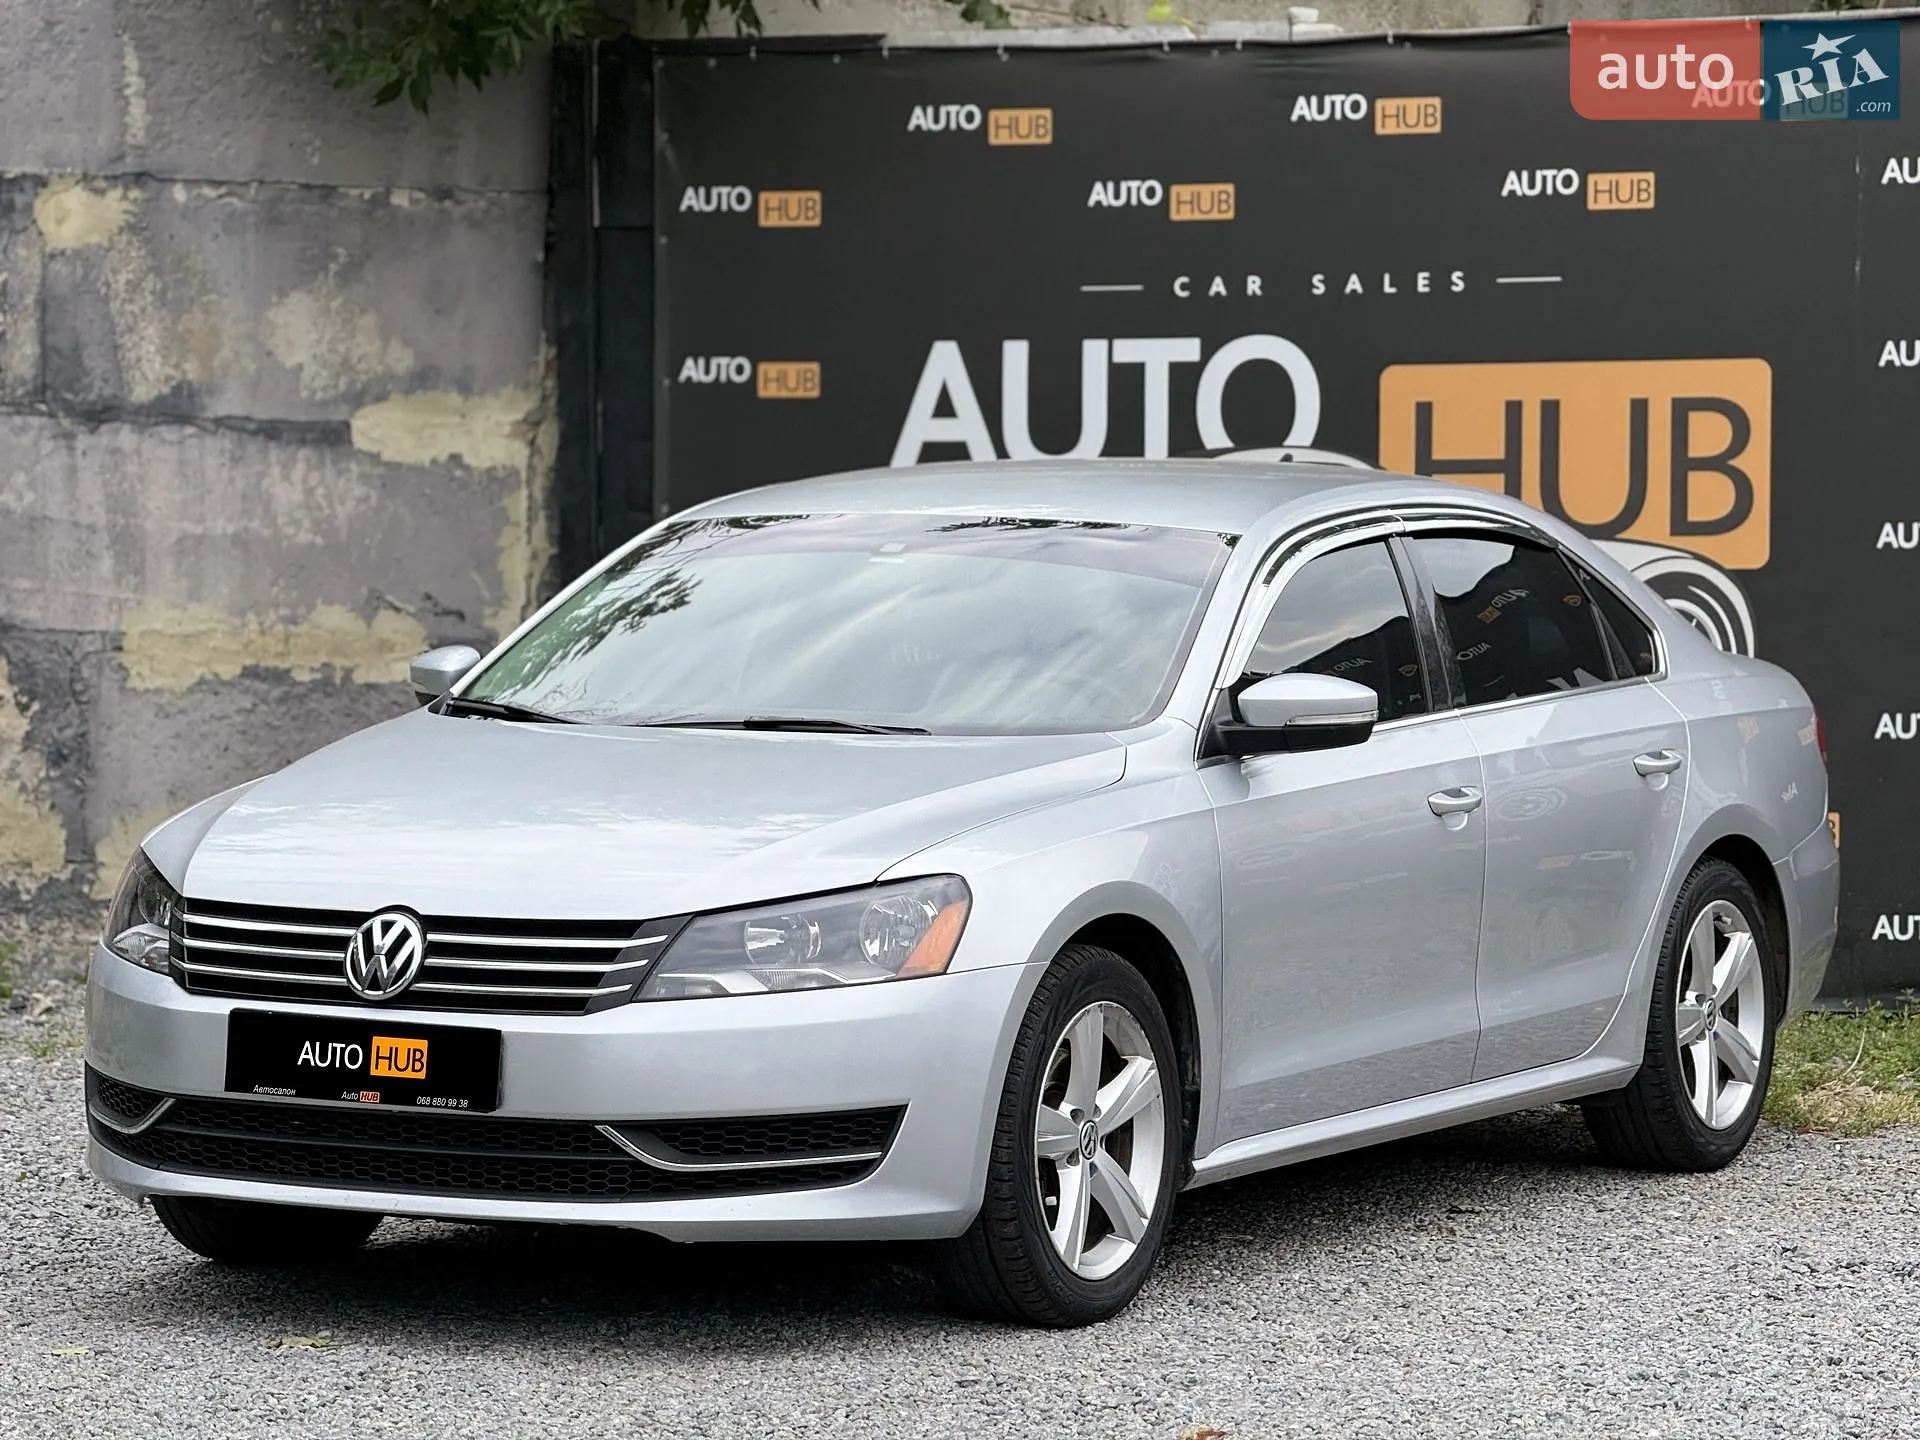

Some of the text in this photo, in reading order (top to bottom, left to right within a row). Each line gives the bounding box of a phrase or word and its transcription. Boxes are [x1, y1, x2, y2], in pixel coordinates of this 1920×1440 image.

[907, 104, 1050, 140] AUTO HUB
[1290, 93, 1438, 130] AUTO HUB
[679, 185, 819, 222] AUTO HUB
[1087, 179, 1232, 215] AUTO HUB
[1501, 168, 1652, 205] AUTO HUB
[1173, 271, 1466, 298] CAR SALES
[678, 356, 818, 393] AUTO HUB
[889, 334, 1756, 538] AUTO HUB
[1876, 521, 1920, 550] AU
[1874, 712, 1920, 740] AU
[297, 1040, 426, 1074] AUTO HUB
[341, 1090, 379, 1102] Auto HUB
[416, 1096, 431, 1106] 068
[447, 1098, 458, 1108] 99
[458, 1099, 469, 1108] 38
